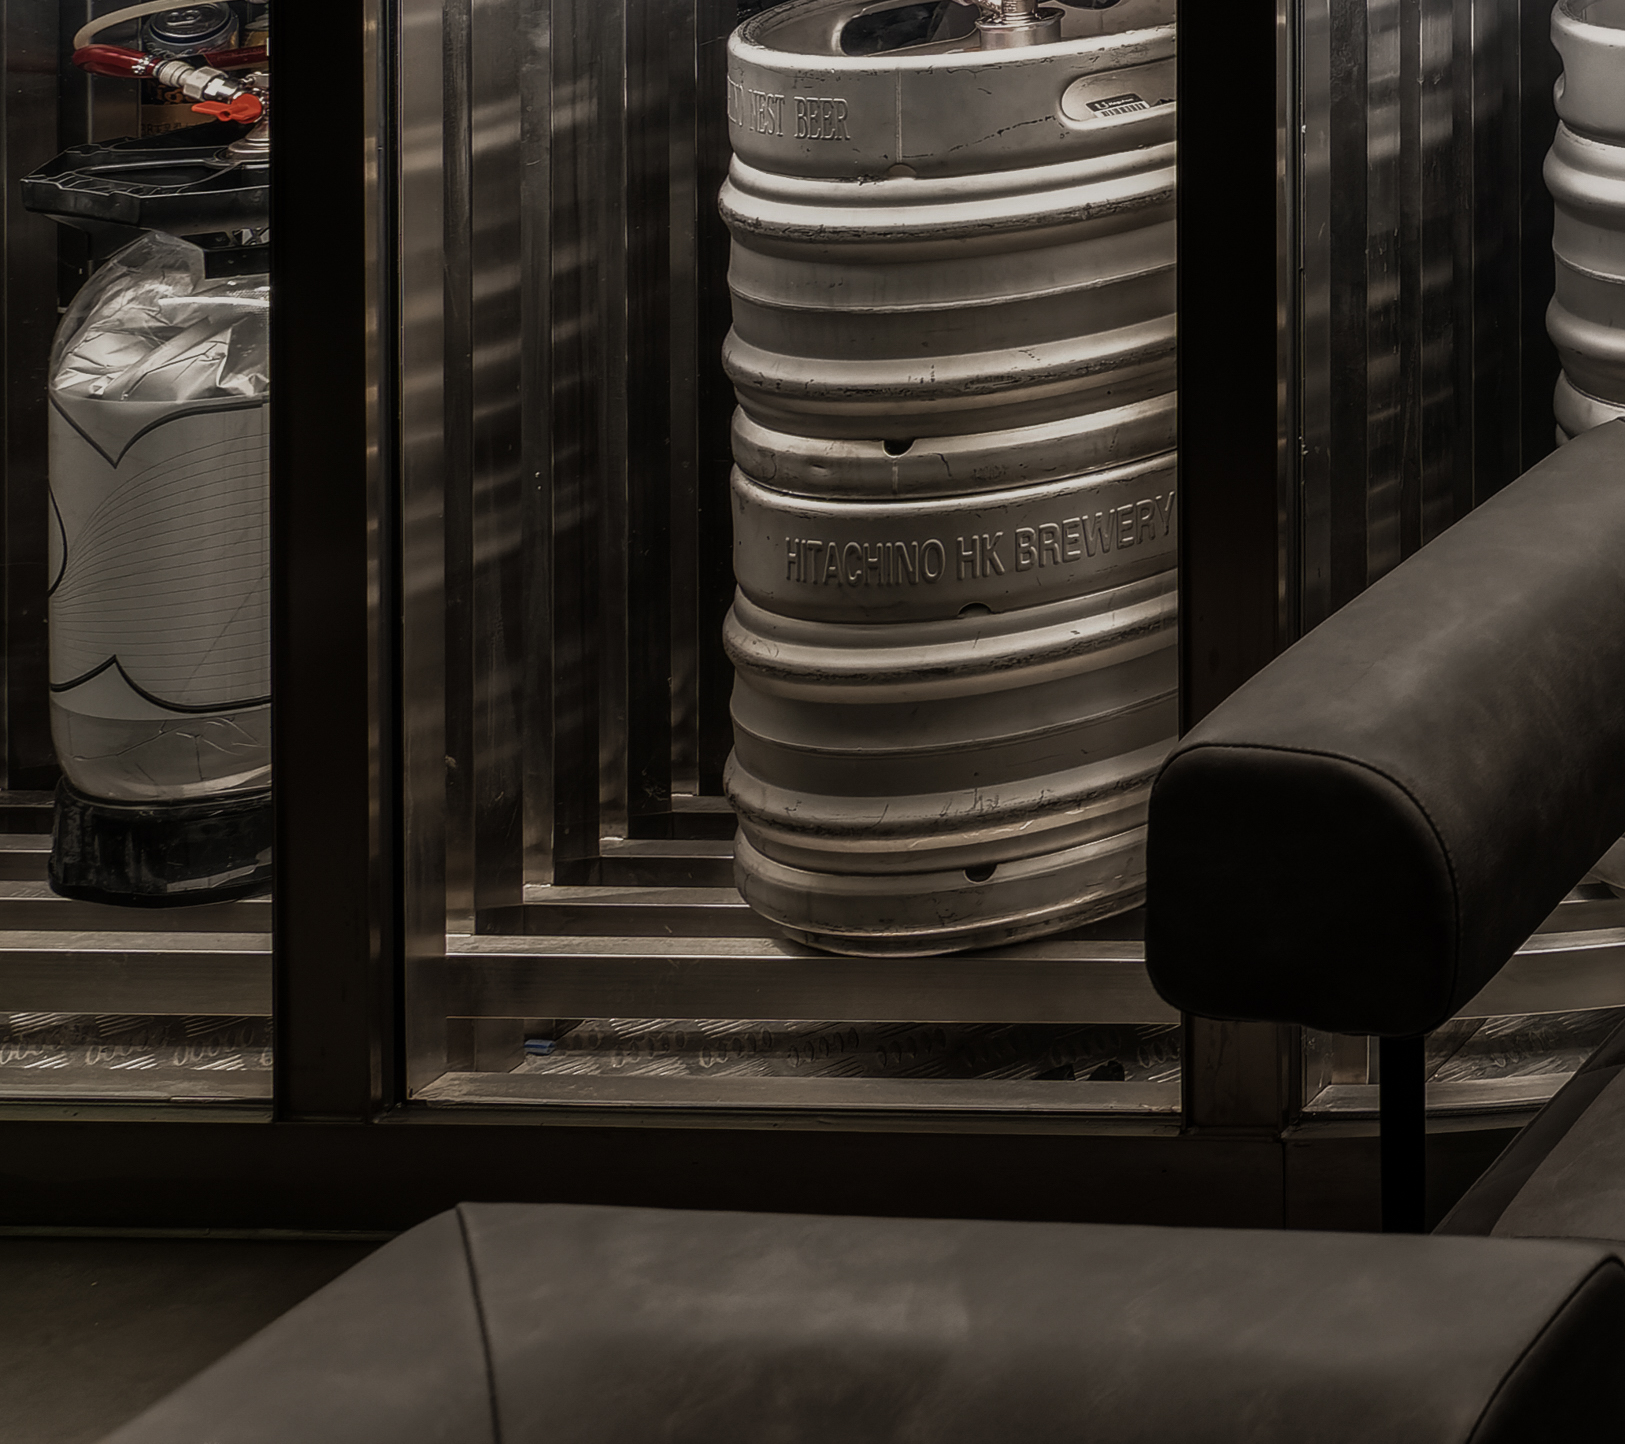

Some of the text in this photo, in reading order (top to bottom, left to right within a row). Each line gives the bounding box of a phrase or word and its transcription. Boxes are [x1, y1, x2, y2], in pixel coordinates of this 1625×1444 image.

[748, 88, 786, 137] NEST
[793, 96, 850, 140] BEER
[785, 490, 1177, 588] HITACHINO HK BREWERY
